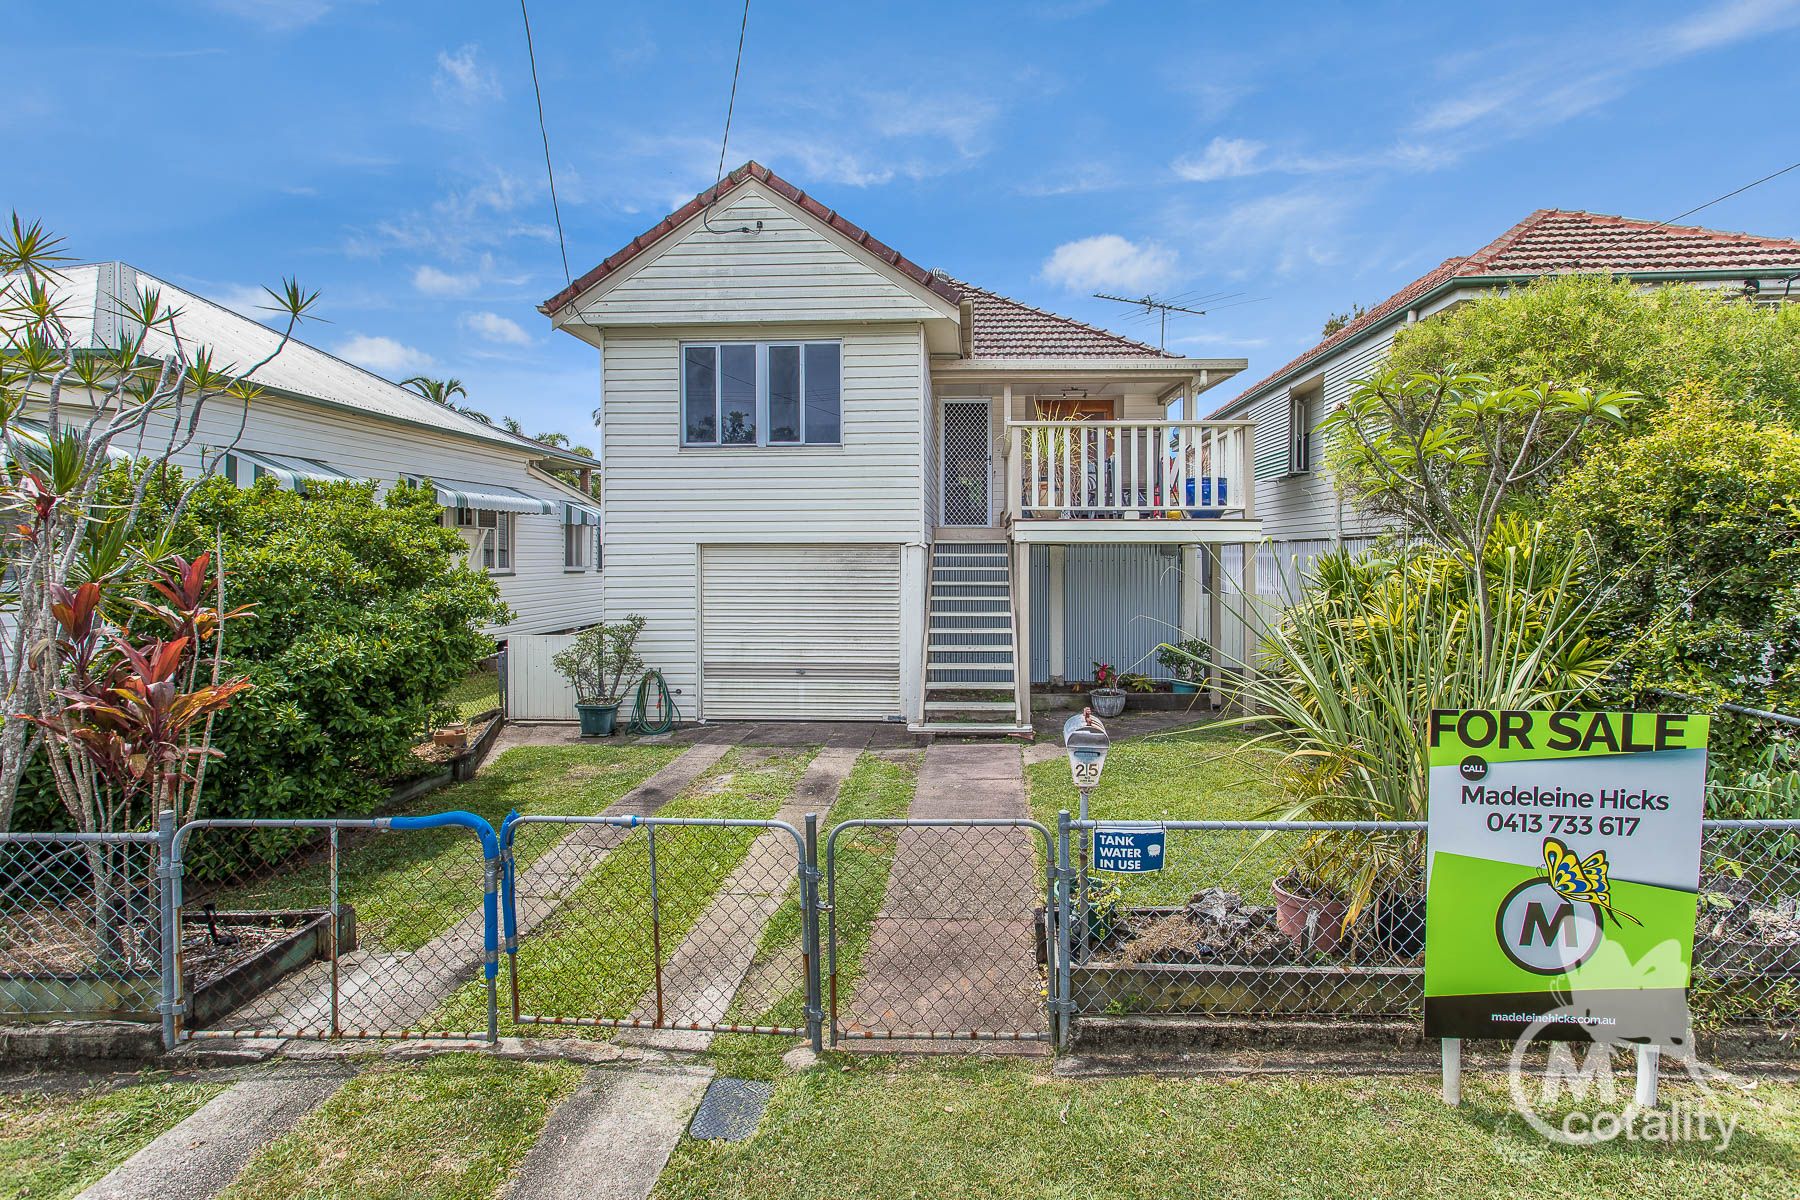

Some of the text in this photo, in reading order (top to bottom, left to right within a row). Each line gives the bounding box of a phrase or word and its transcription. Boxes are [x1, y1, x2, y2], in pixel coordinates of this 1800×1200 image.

[1431, 710, 1689, 753] FOR SALE
[1075, 764, 1098, 777] 25
[1462, 764, 1485, 774] CALL
[1461, 785, 1670, 811] Madeleine Hicks
[1487, 812, 1641, 837] 0413 733 617
[1100, 835, 1135, 846] TANK
[1100, 847, 1142, 858] WATER
[1100, 859, 1141, 869] IN USE
[1519, 902, 1578, 948] M
[1491, 1012, 1616, 1025] madeleinehicks.com.au
